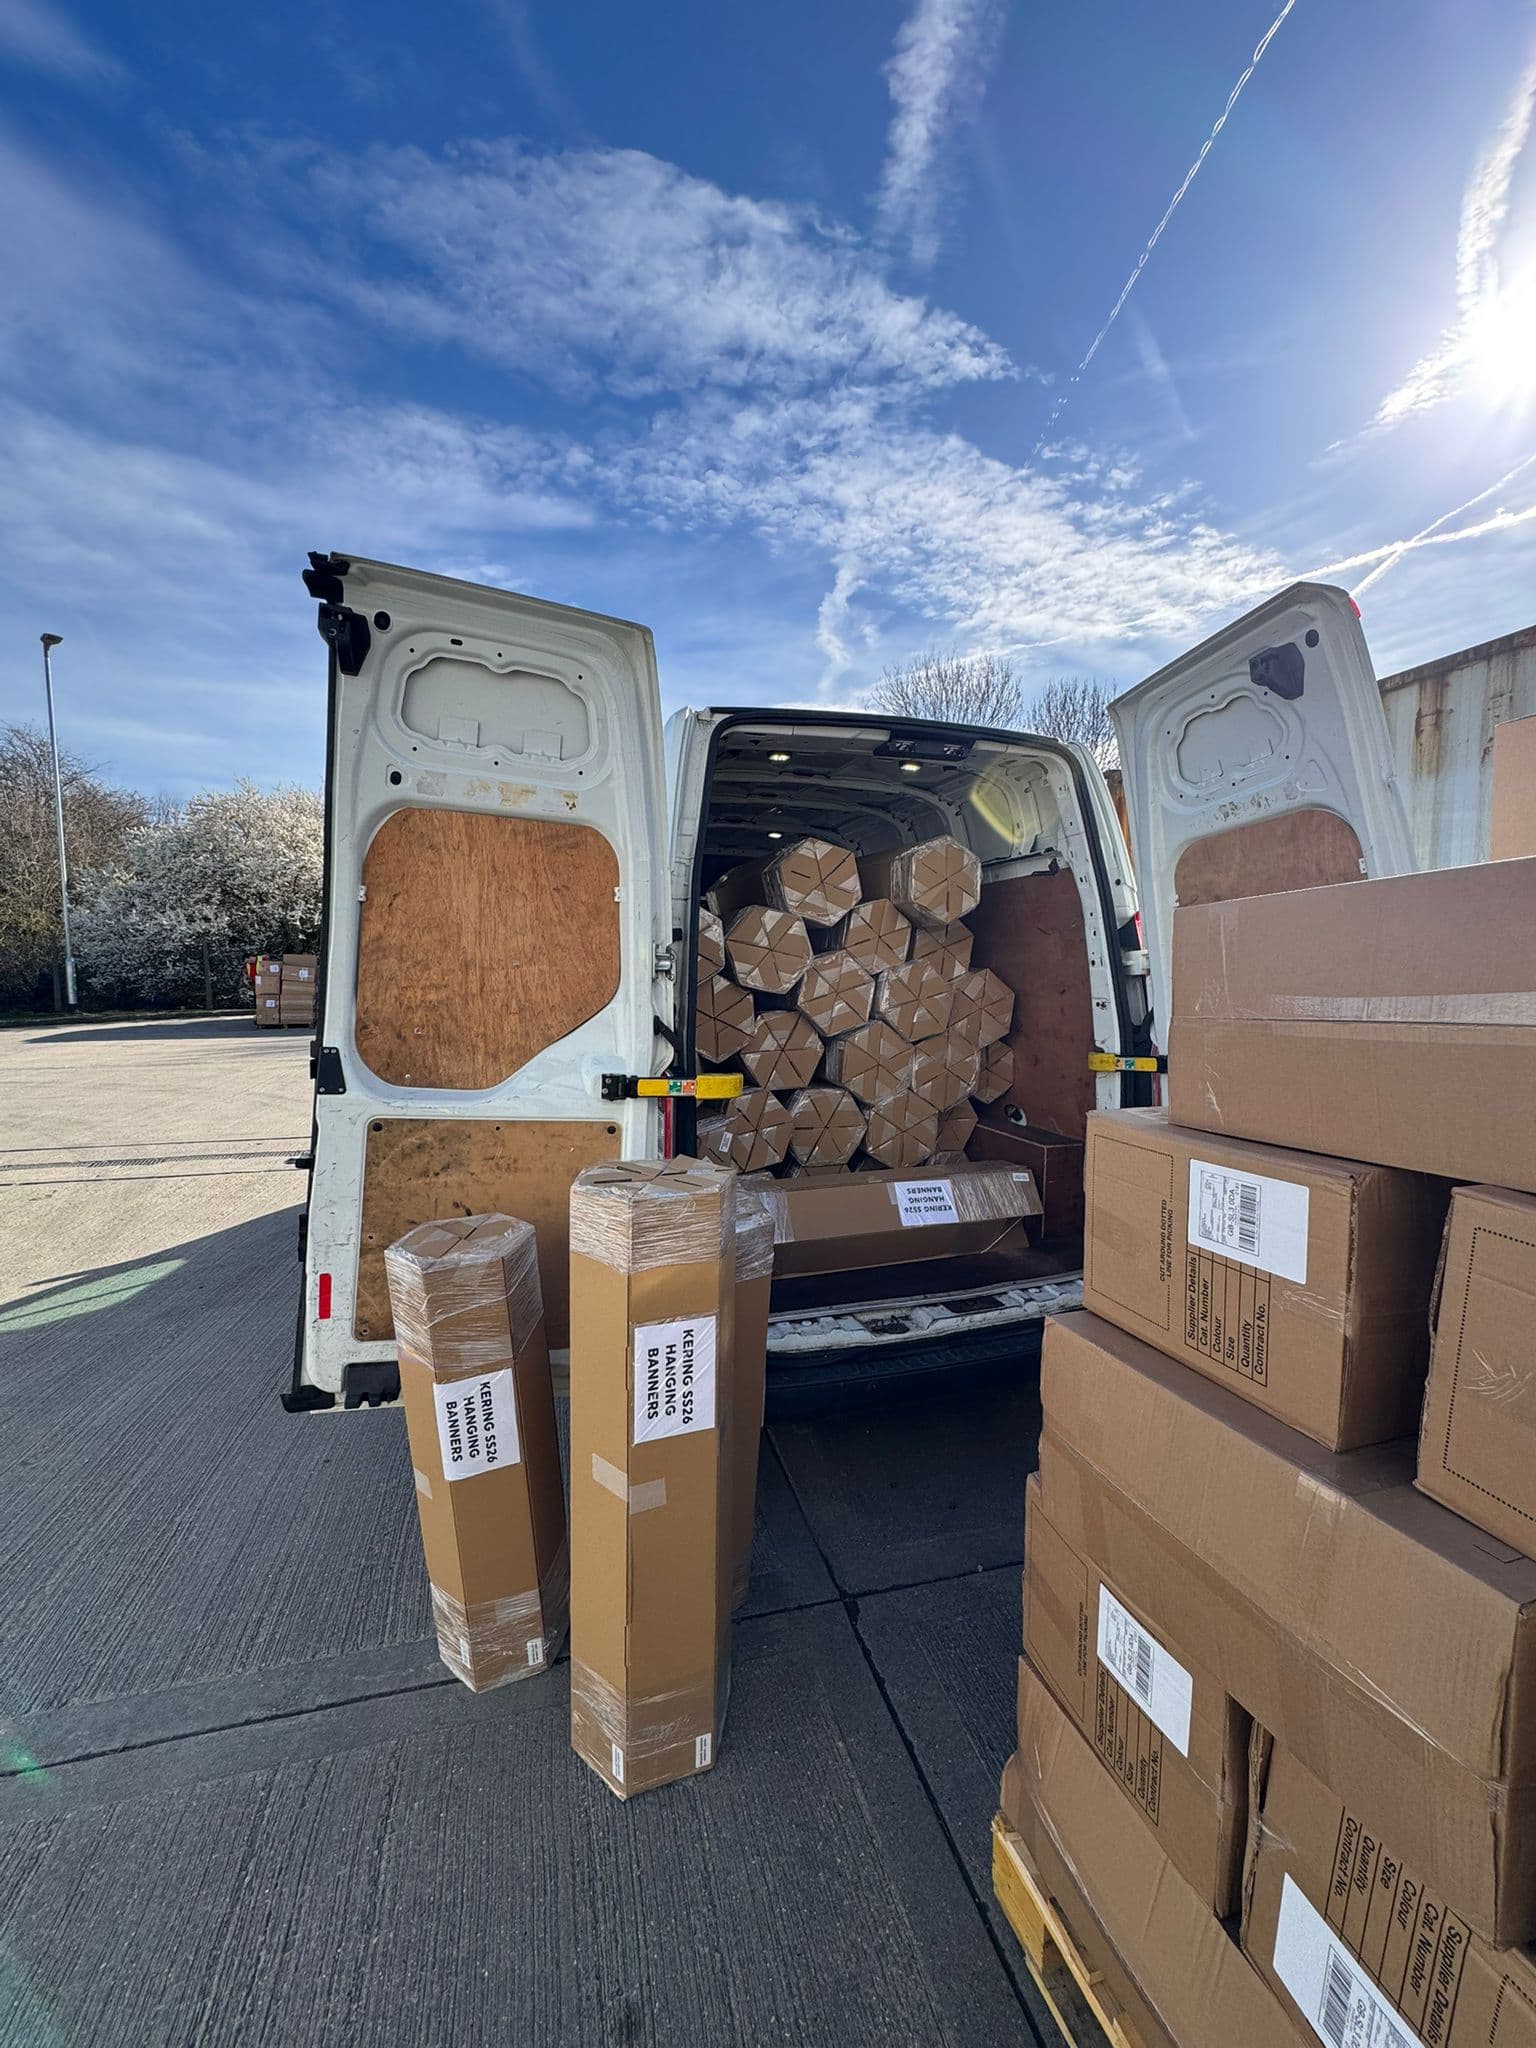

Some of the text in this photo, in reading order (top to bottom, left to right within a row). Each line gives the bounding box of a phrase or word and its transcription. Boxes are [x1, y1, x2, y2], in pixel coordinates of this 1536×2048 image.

[904, 1204, 952, 1214] KERING SS26
[906, 1186, 942, 1194] BANNERS
[908, 1196, 944, 1204] HANGING
[1187, 1257, 1196, 1340] Supplier Details
[1200, 1278, 1209, 1346] Cat. Number
[1213, 1315, 1222, 1353] Colour
[1226, 1336, 1235, 1360] Size
[1241, 1320, 1252, 1368] Quantity
[1255, 1303, 1266, 1374] Contract No.
[648, 1348, 659, 1420] BANNERS
[665, 1344, 676, 1416] HANGING
[682, 1329, 694, 1424] KERING SS26
[446, 1401, 462, 1462] BANNERS
[464, 1396, 480, 1458] HANGING
[480, 1381, 498, 1463] KERING SS26
[1116, 1736, 1124, 1770] Colour
[1138, 1755, 1148, 1800] Quantity
[1148, 1751, 1159, 1812] Contract No.
[1334, 1817, 1358, 1896] Contract No.
[1354, 1836, 1375, 1896] Quantity
[1380, 1857, 1396, 1890] Size
[1398, 1880, 1416, 1931] Colour
[1410, 1903, 1438, 1997] Cat. Number
[1427, 1926, 1462, 2044] Supplier Details
